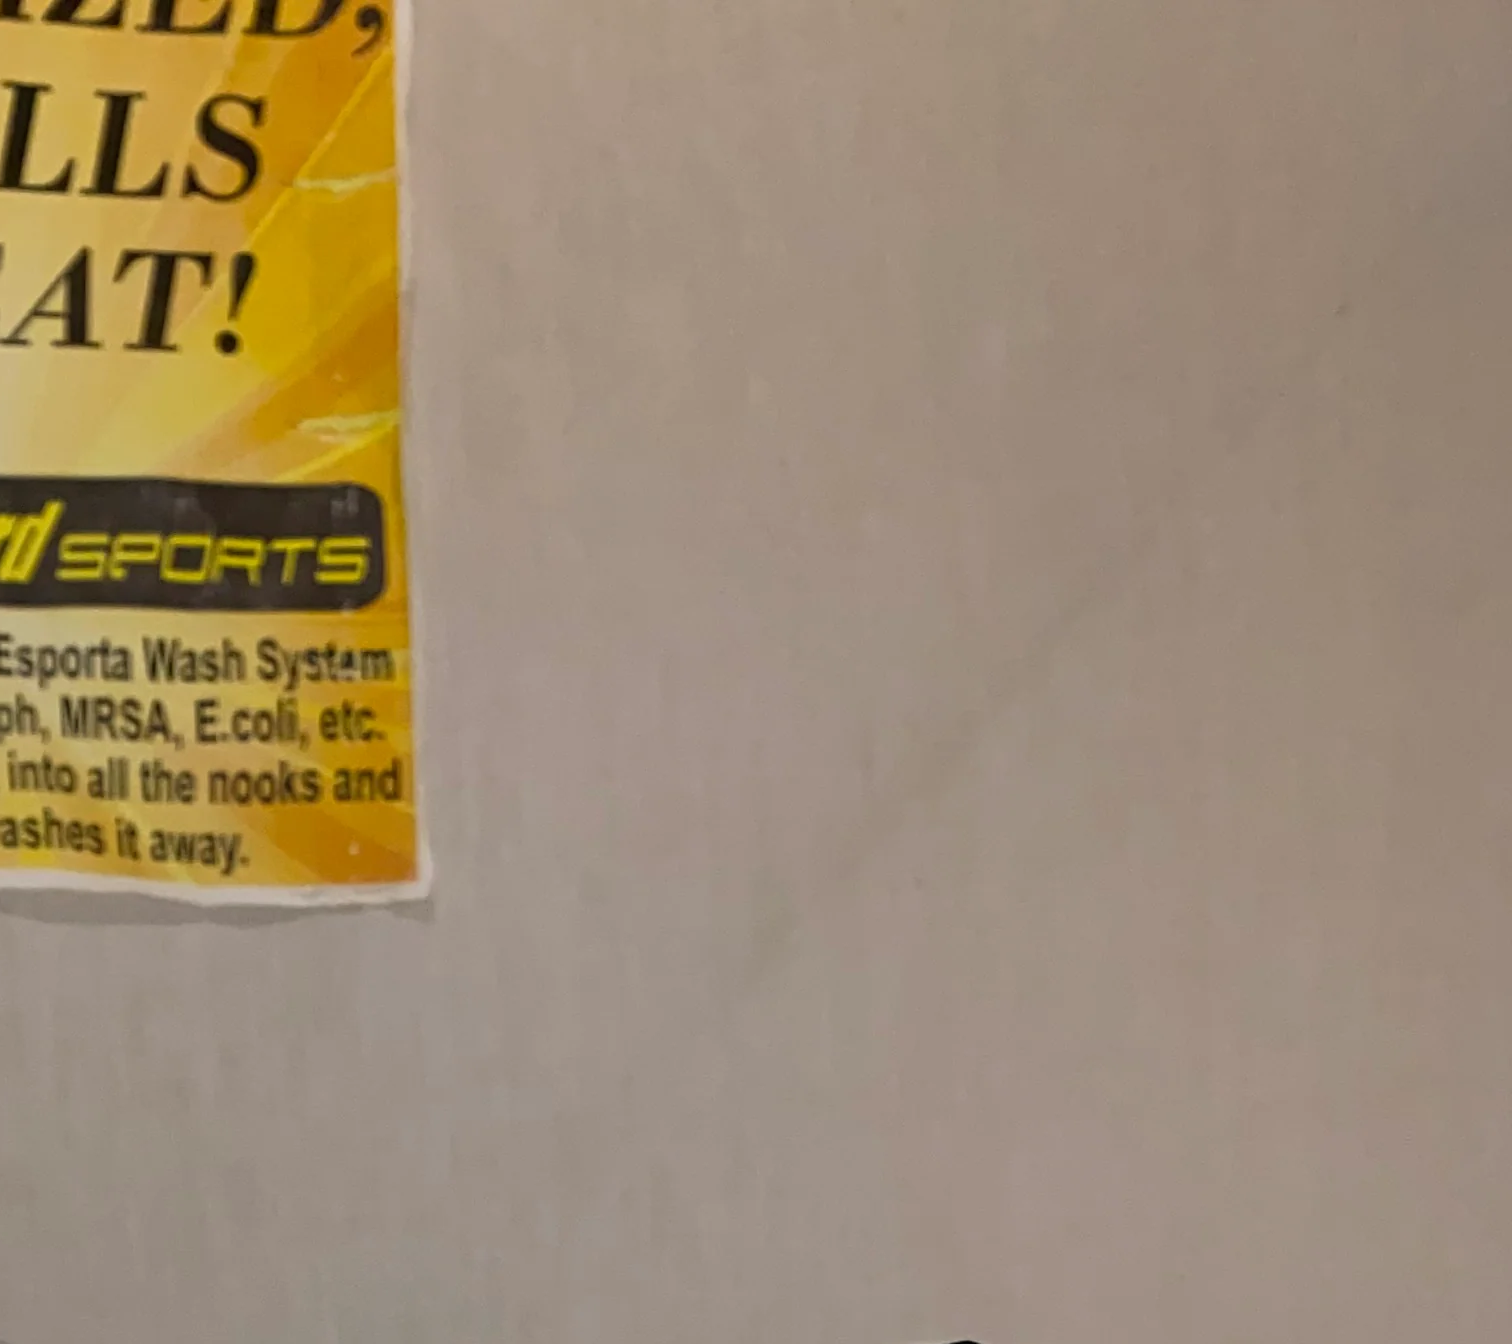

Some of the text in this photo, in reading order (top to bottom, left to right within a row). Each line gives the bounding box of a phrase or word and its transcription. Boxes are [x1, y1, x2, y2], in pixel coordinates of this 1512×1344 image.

[54, 532, 372, 586] SPORTS
[142, 637, 246, 683] Wash
[60, 694, 185, 750] MRSA,
[194, 698, 309, 750] E.coli,
[318, 702, 386, 744] etc.
[7, 750, 78, 793] into
[87, 756, 130, 800] all
[140, 758, 196, 803] the
[208, 758, 322, 806] nooks
[334, 757, 402, 801] and
[115, 817, 141, 862] it
[149, 830, 250, 877] away.
